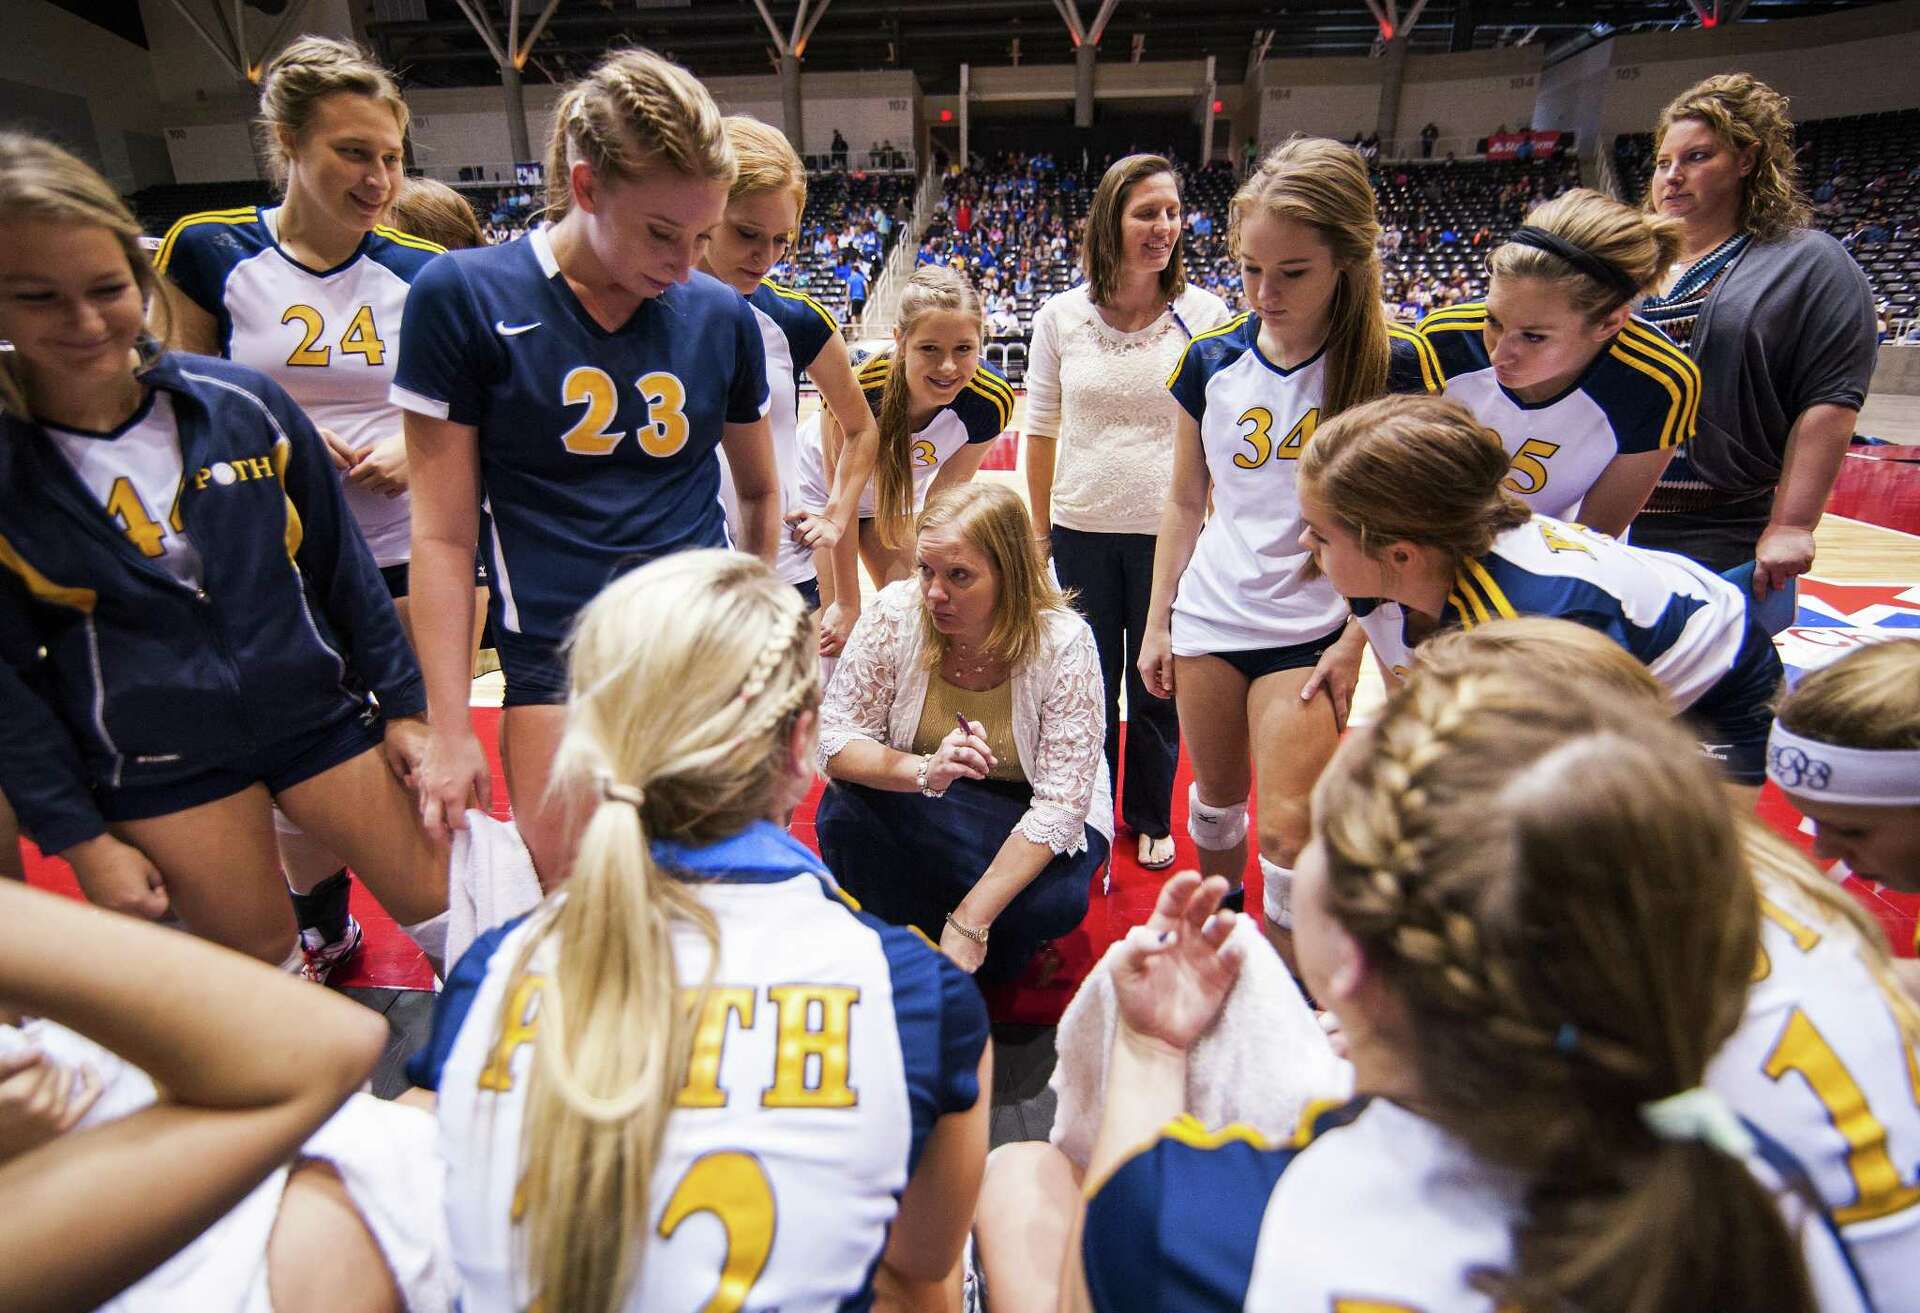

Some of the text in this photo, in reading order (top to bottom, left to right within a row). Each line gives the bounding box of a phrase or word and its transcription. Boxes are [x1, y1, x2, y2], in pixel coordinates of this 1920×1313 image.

[281, 304, 386, 367] 24
[561, 366, 690, 458] 23
[1233, 406, 1321, 470] 34
